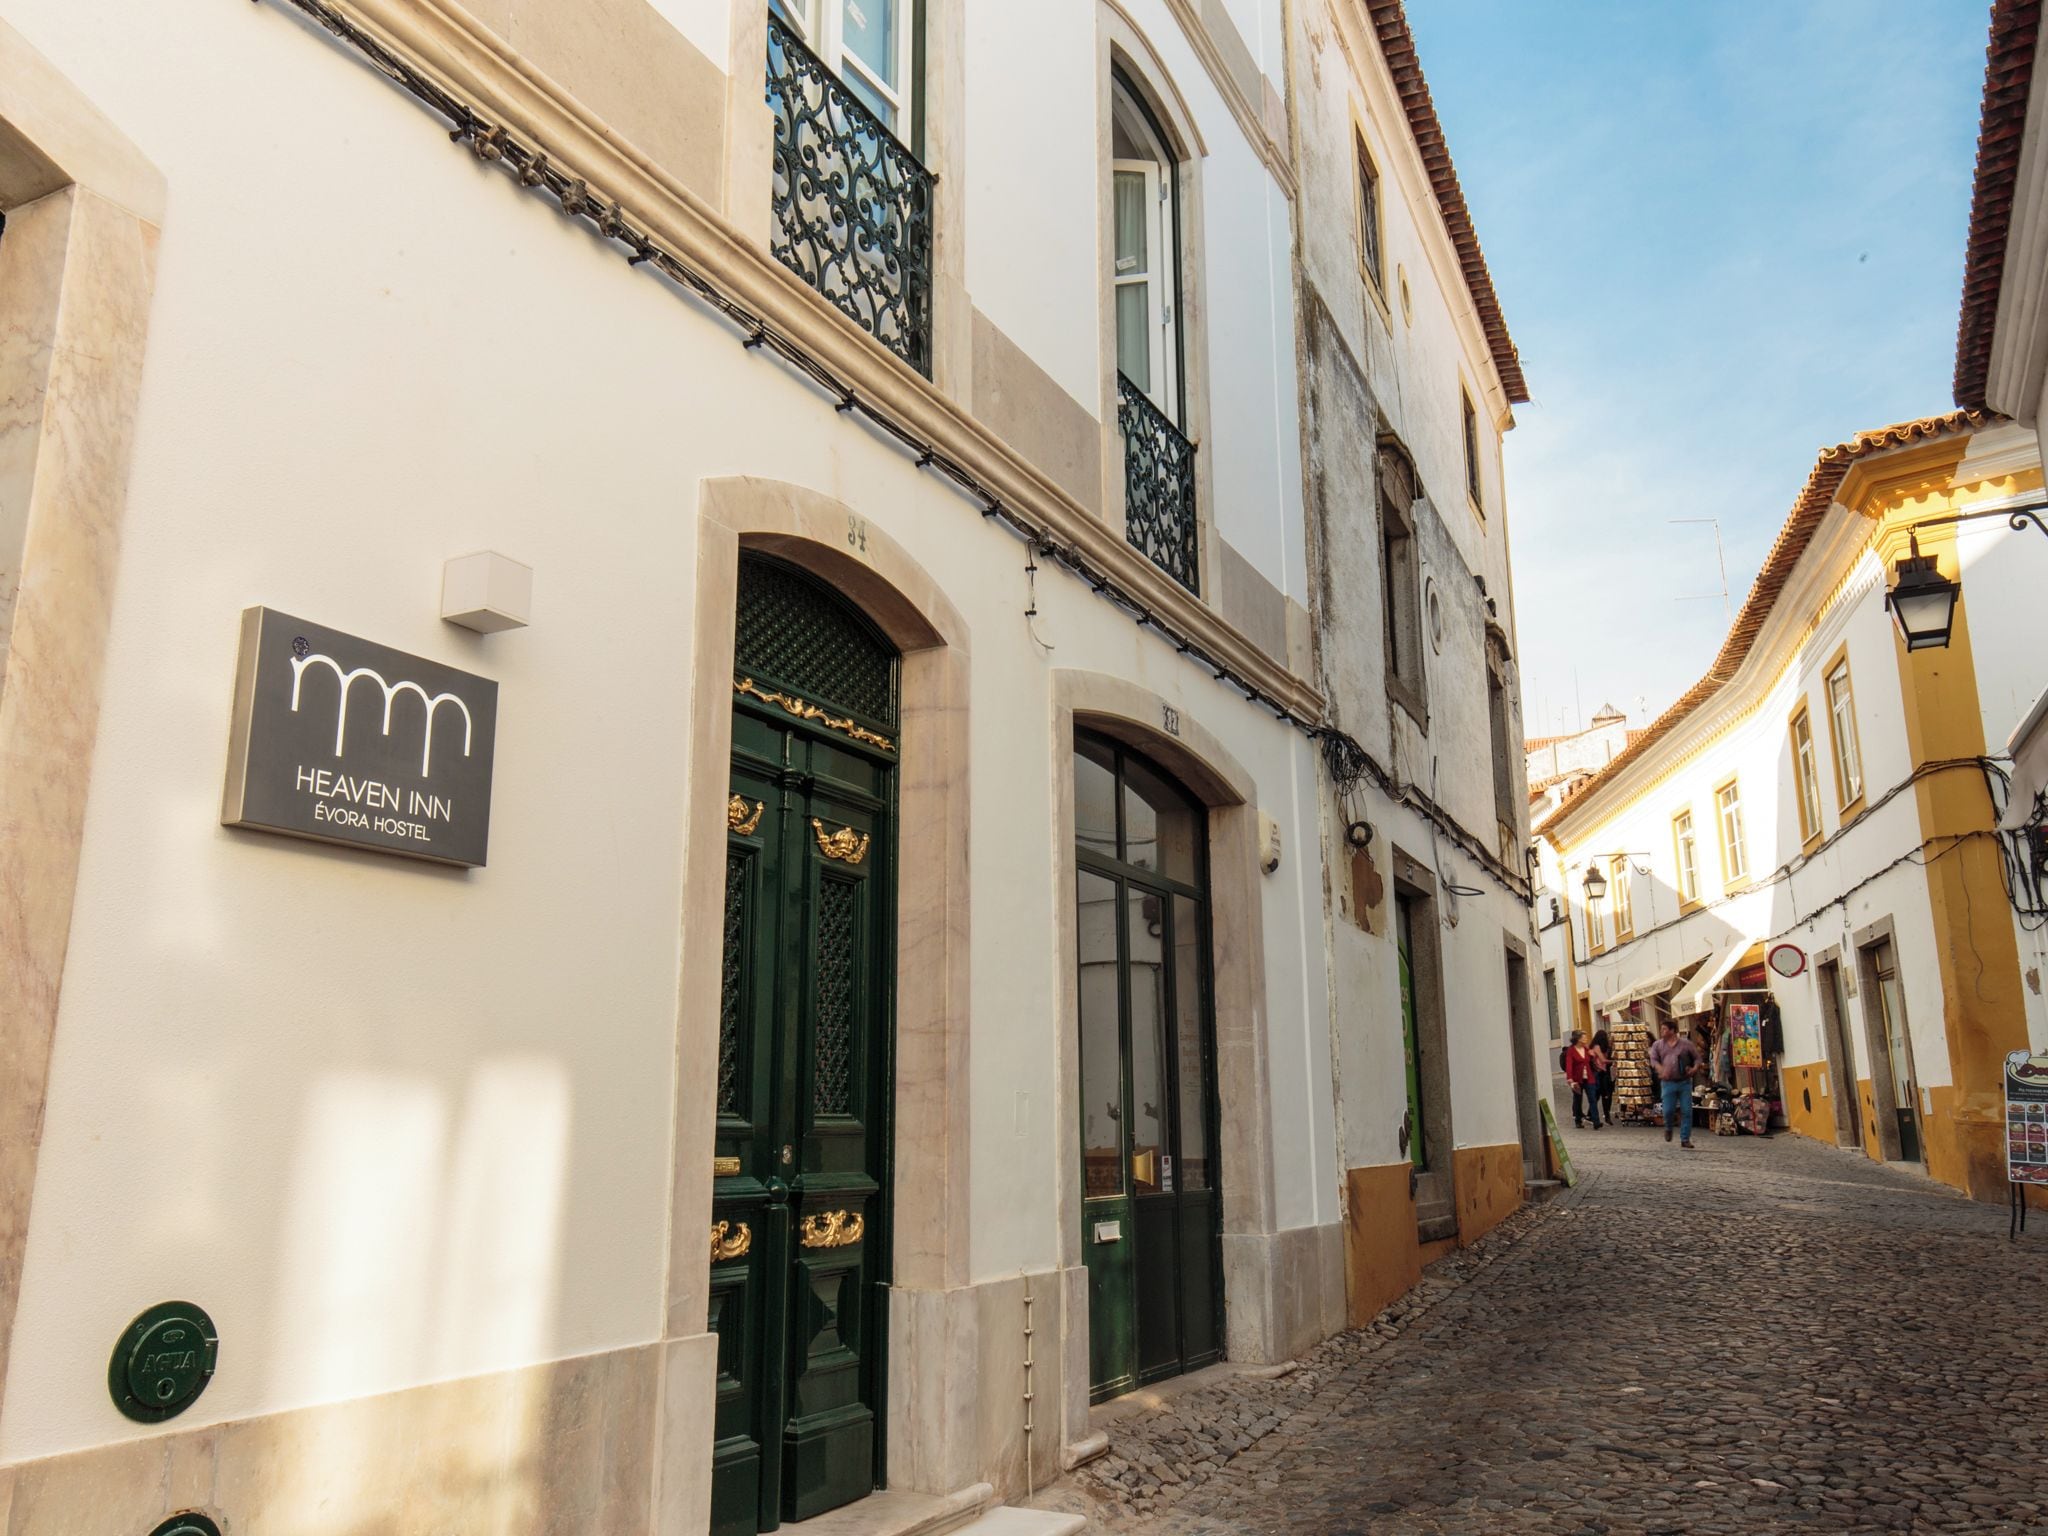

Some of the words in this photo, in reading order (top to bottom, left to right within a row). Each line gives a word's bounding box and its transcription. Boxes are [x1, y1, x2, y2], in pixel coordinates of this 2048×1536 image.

[848, 515, 866, 552] 34
[296, 765, 400, 811] HEAVEN
[409, 790, 451, 822] INN
[314, 801, 369, 829] ÉVORA
[374, 817, 430, 841] HOSTEL
[142, 1350, 196, 1373] AGUA
